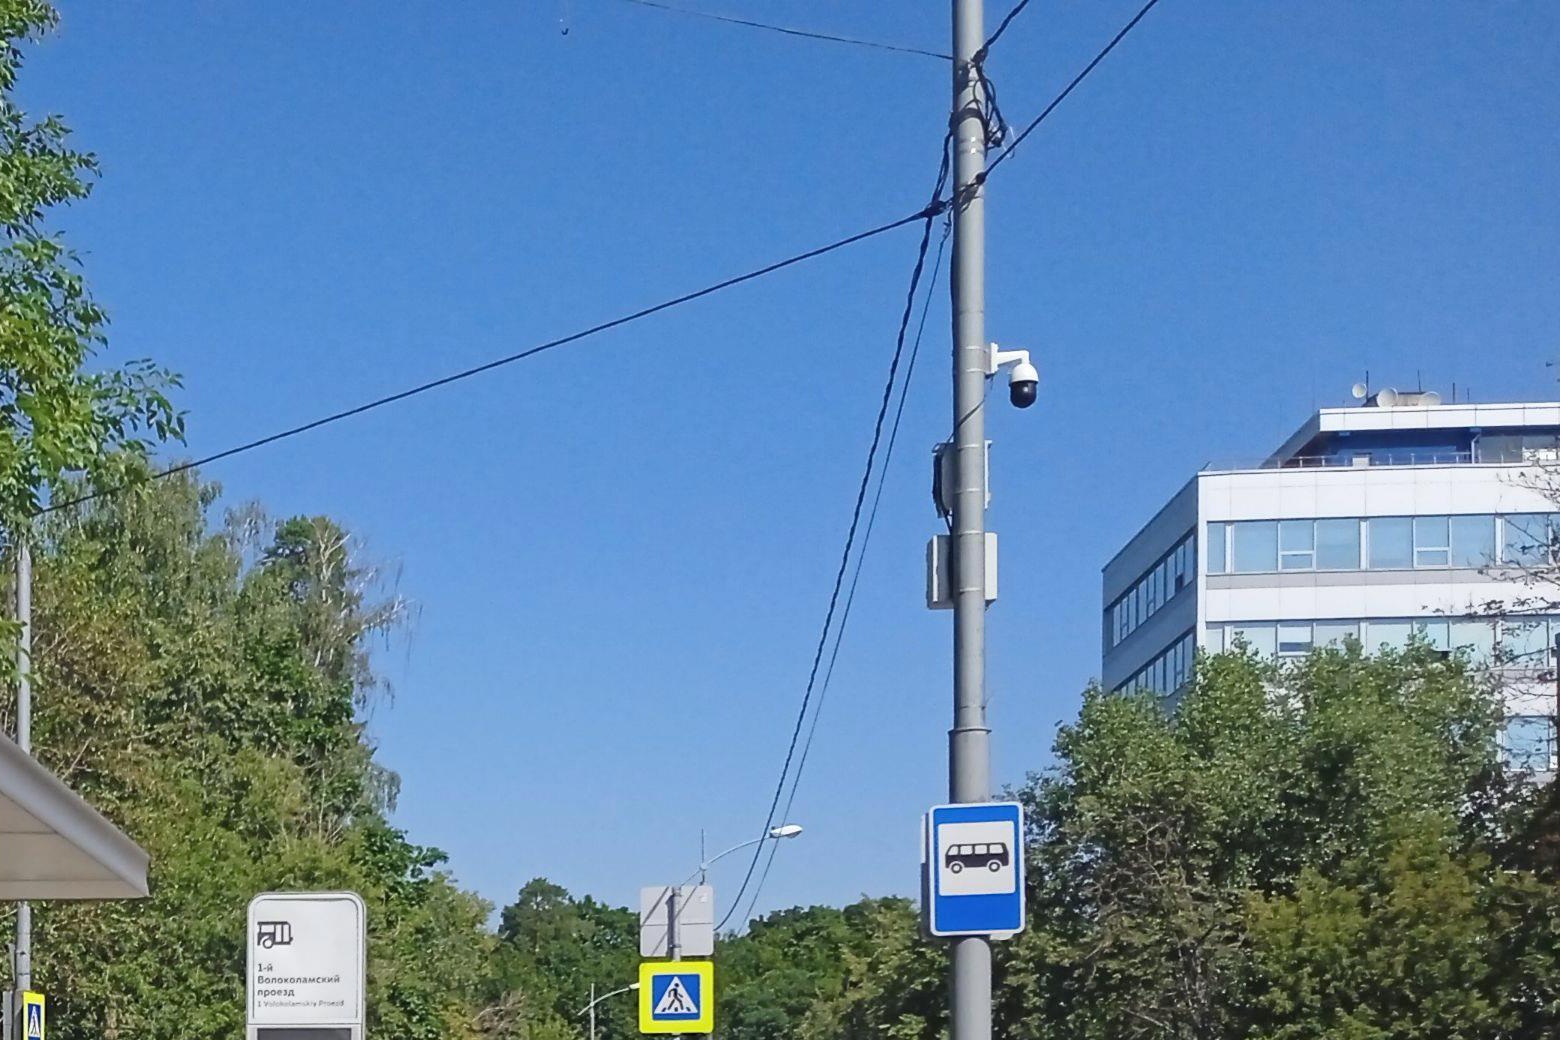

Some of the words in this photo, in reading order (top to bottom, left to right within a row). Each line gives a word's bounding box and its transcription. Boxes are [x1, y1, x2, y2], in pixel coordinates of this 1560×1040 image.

[258, 963, 273, 972] 1-й
[257, 975, 340, 984] Волоколамский
[257, 989, 295, 997] проезд
